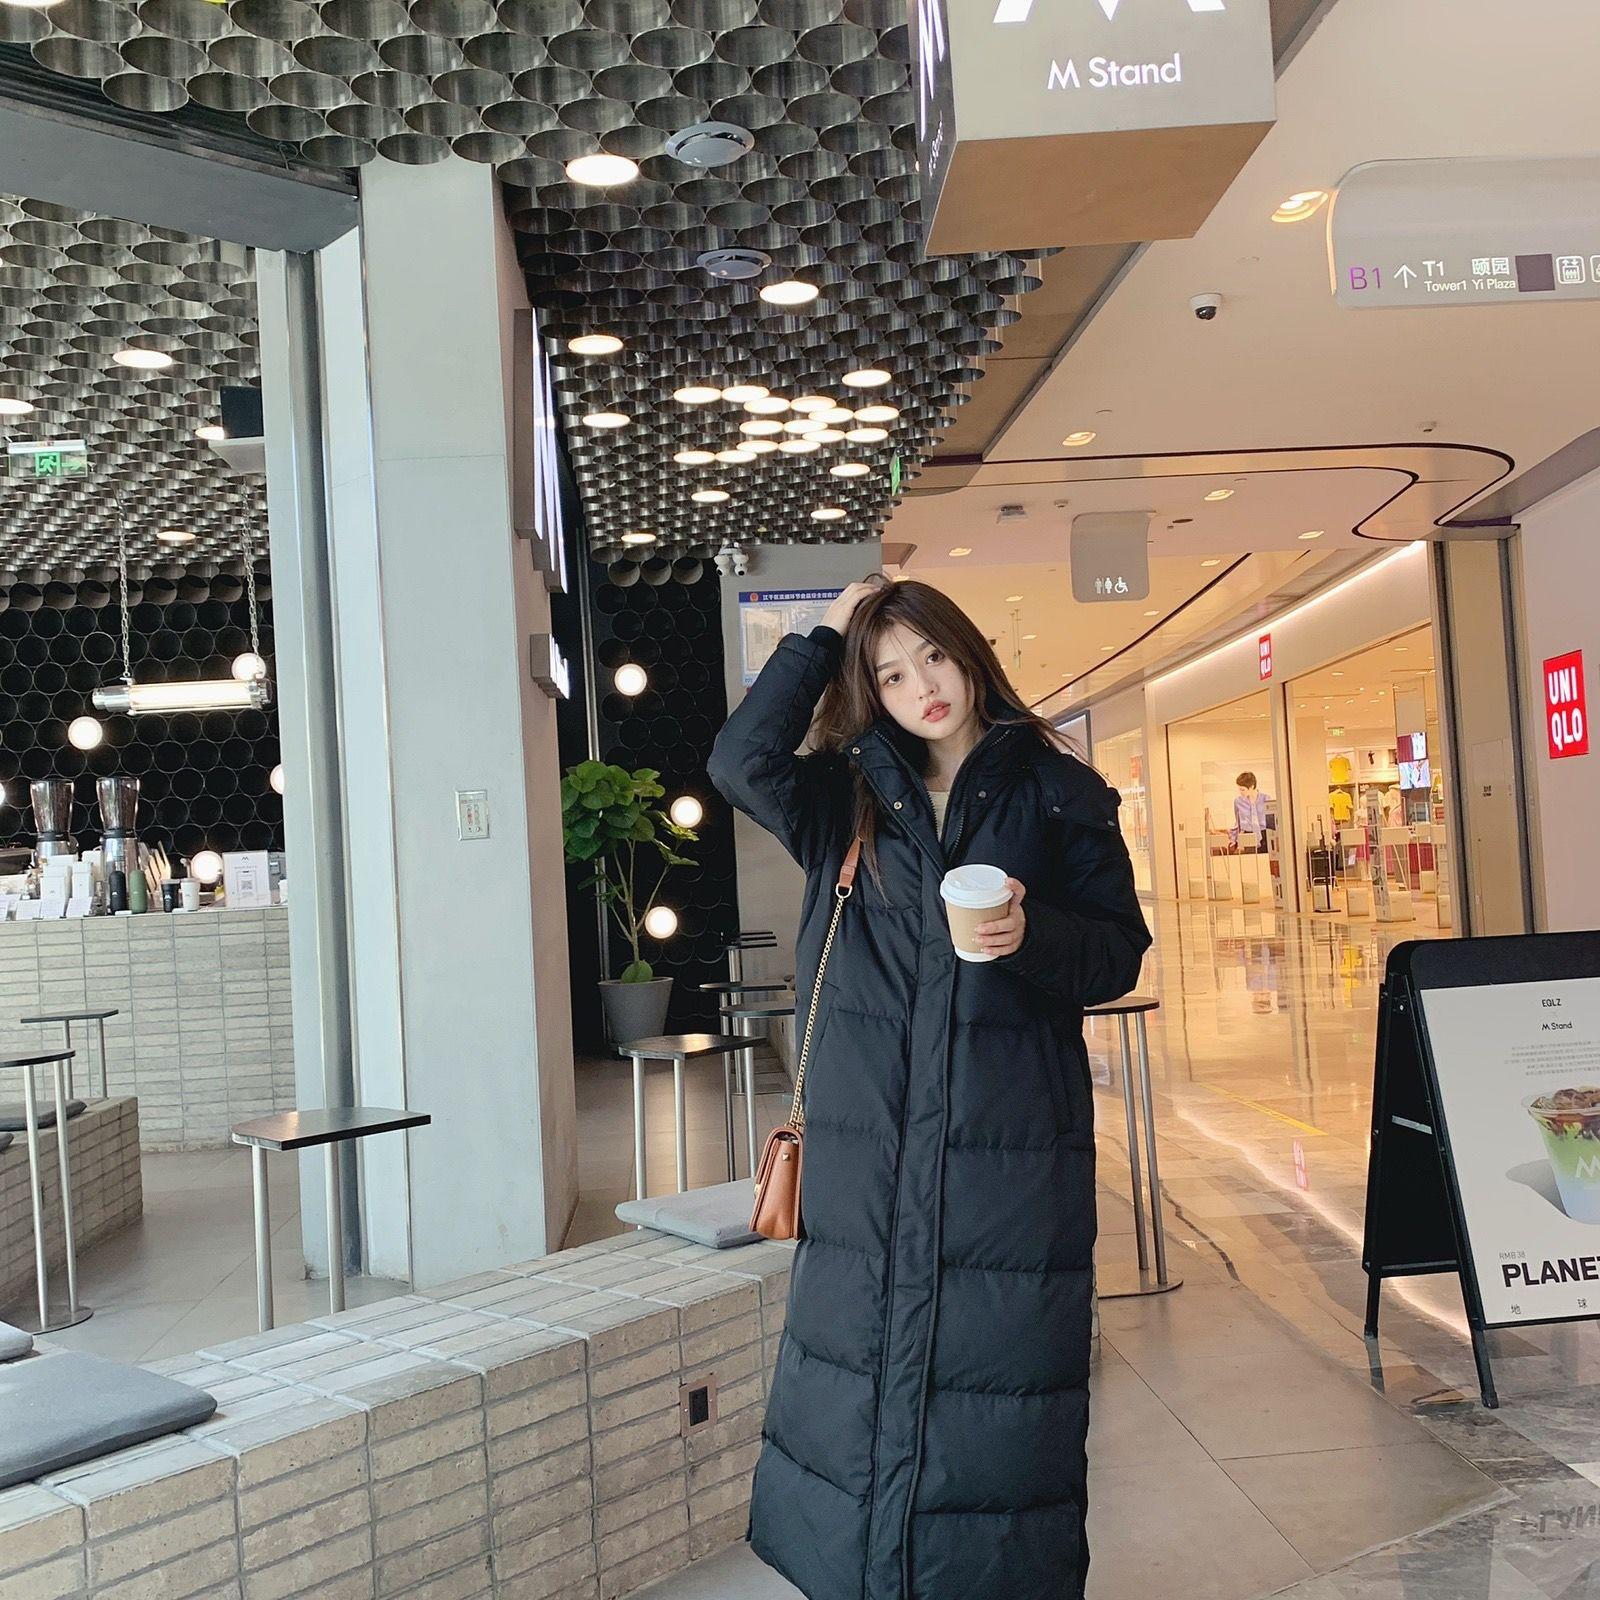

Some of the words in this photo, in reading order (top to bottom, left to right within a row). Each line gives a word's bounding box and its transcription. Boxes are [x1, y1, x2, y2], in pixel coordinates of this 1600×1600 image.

[1046, 58, 1081, 90] M
[1087, 52, 1183, 88] Stand
[1349, 266, 1382, 290] B1
[1421, 259, 1445, 278] T1
[1471, 257, 1511, 276] 颐园
[1423, 280, 1468, 292] Tower1
[1472, 279, 1486, 291] Yi
[1487, 278, 1516, 290] Plaza
[1547, 665, 1578, 705] UNI
[1550, 706, 1583, 752] QLO
[1551, 1020, 1573, 1031] Stand
[1501, 1254, 1600, 1288] PLANE
